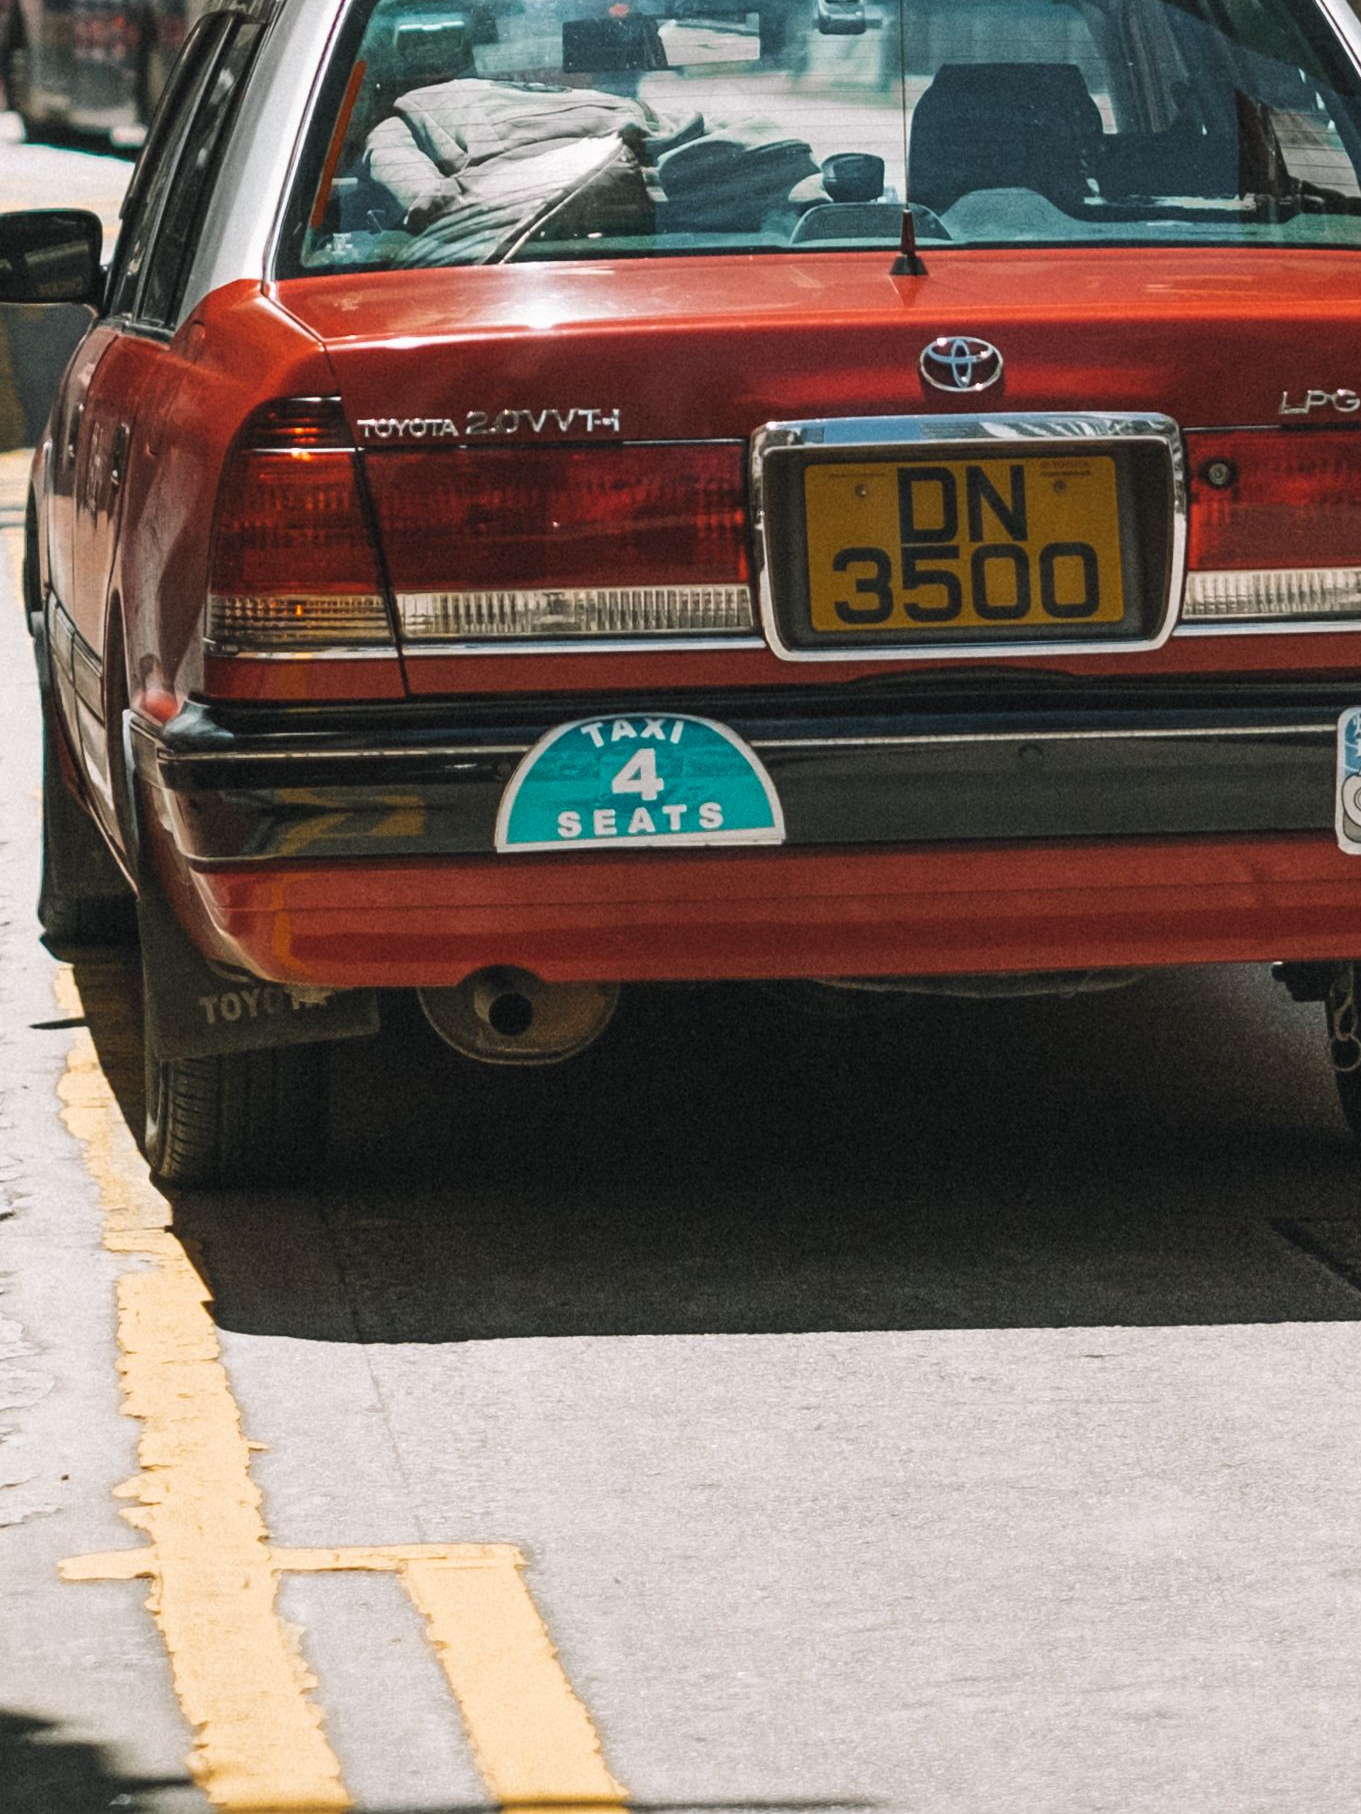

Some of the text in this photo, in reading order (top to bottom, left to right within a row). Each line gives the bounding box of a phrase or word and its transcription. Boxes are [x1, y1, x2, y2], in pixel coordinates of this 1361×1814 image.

[1279, 388, 1361, 415] LPG
[357, 417, 459, 438] TOYOTA
[897, 464, 1028, 544] DN
[832, 541, 1101, 625] 3500
[580, 718, 684, 748] TAXI
[611, 748, 665, 801] 4
[557, 802, 724, 838] SEATS
[199, 985, 330, 1024] TOYO
